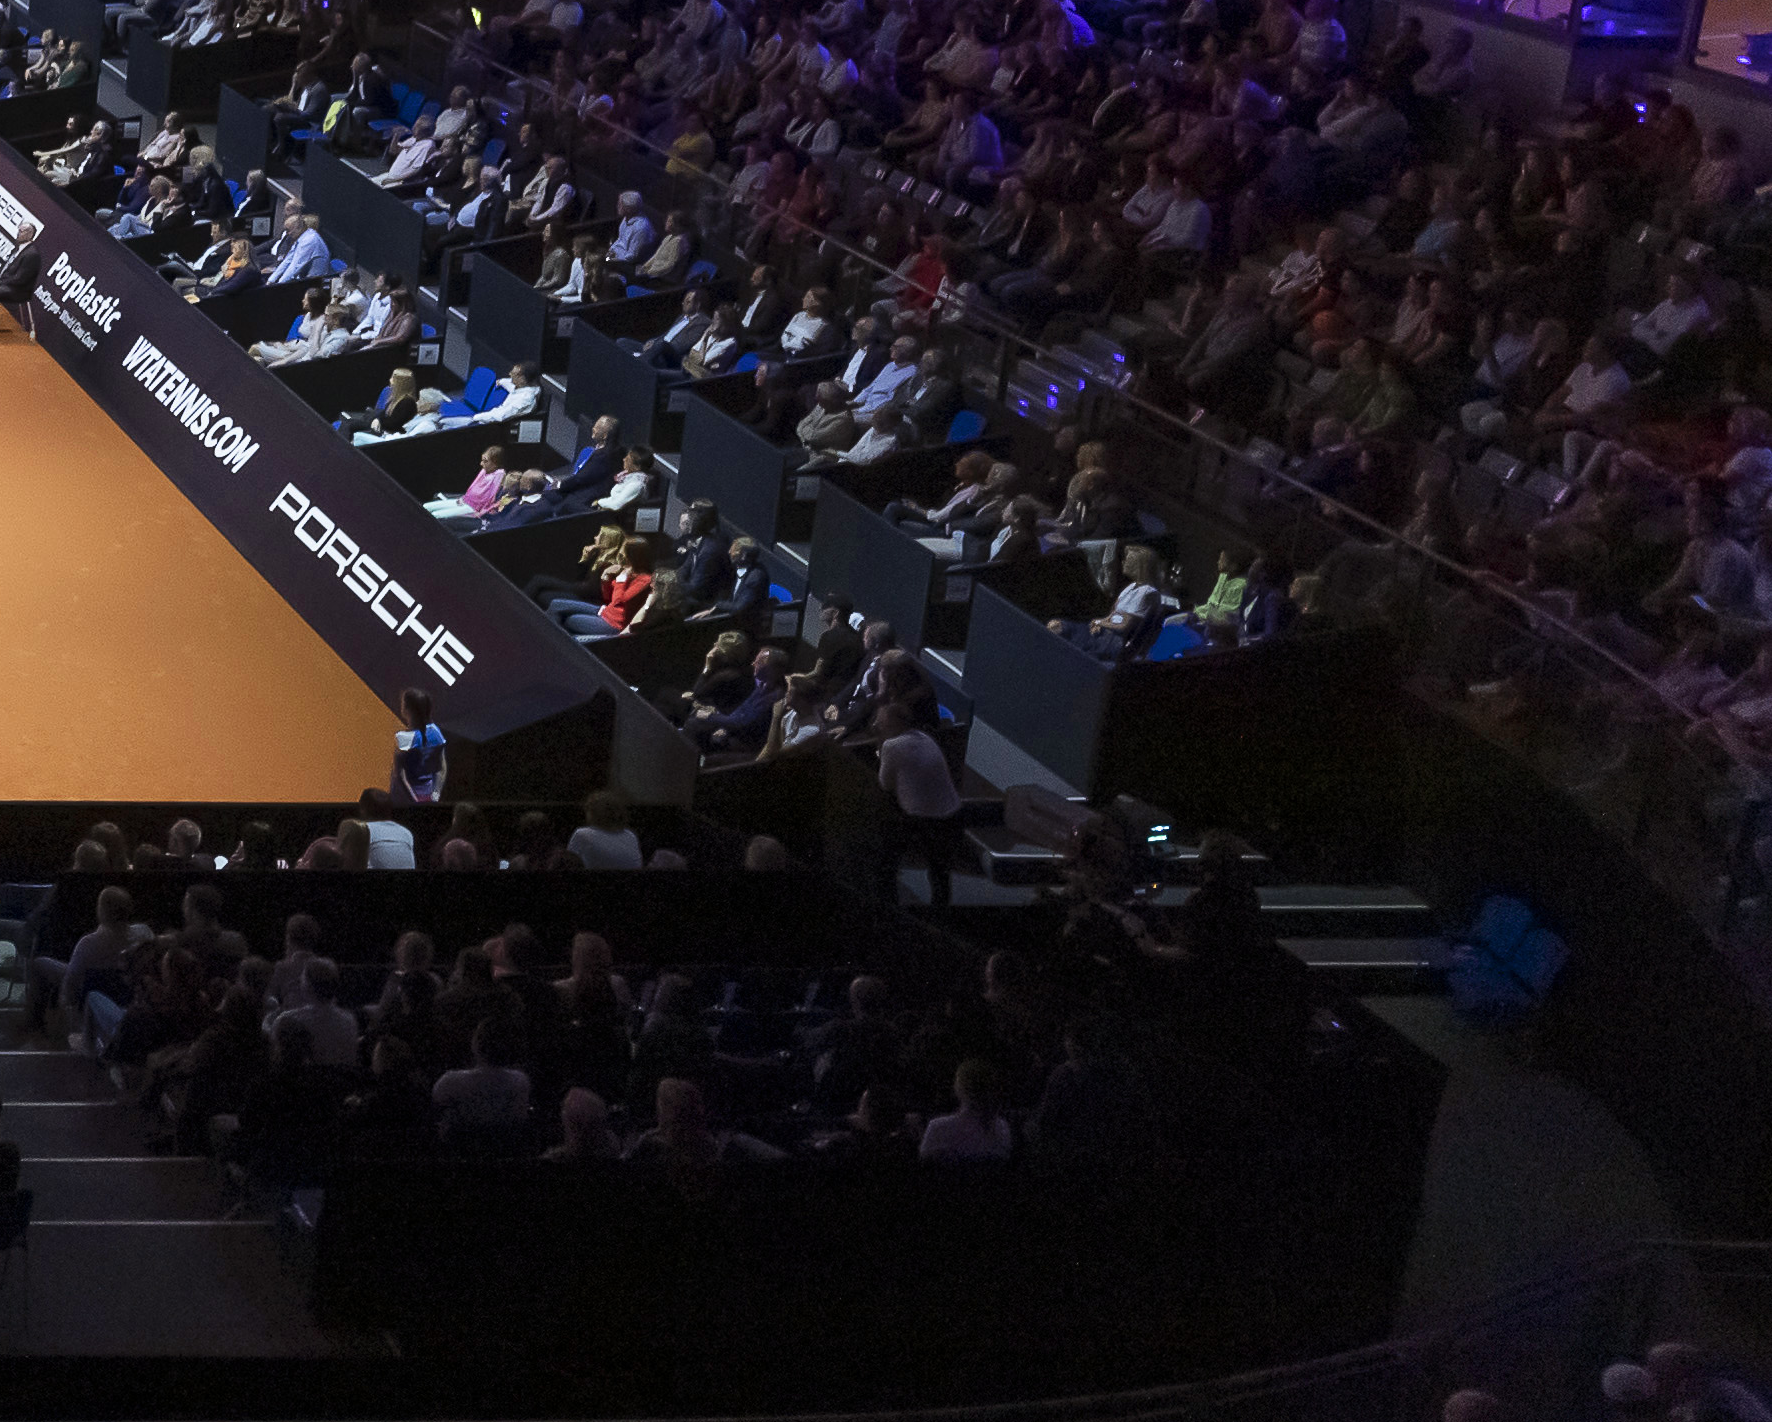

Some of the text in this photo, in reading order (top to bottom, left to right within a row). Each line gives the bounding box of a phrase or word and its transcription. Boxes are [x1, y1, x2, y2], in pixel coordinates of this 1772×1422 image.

[47, 251, 122, 334] Porplastic
[122, 335, 260, 474] WTATENNIS.COM
[268, 482, 475, 686] PORSCHE
